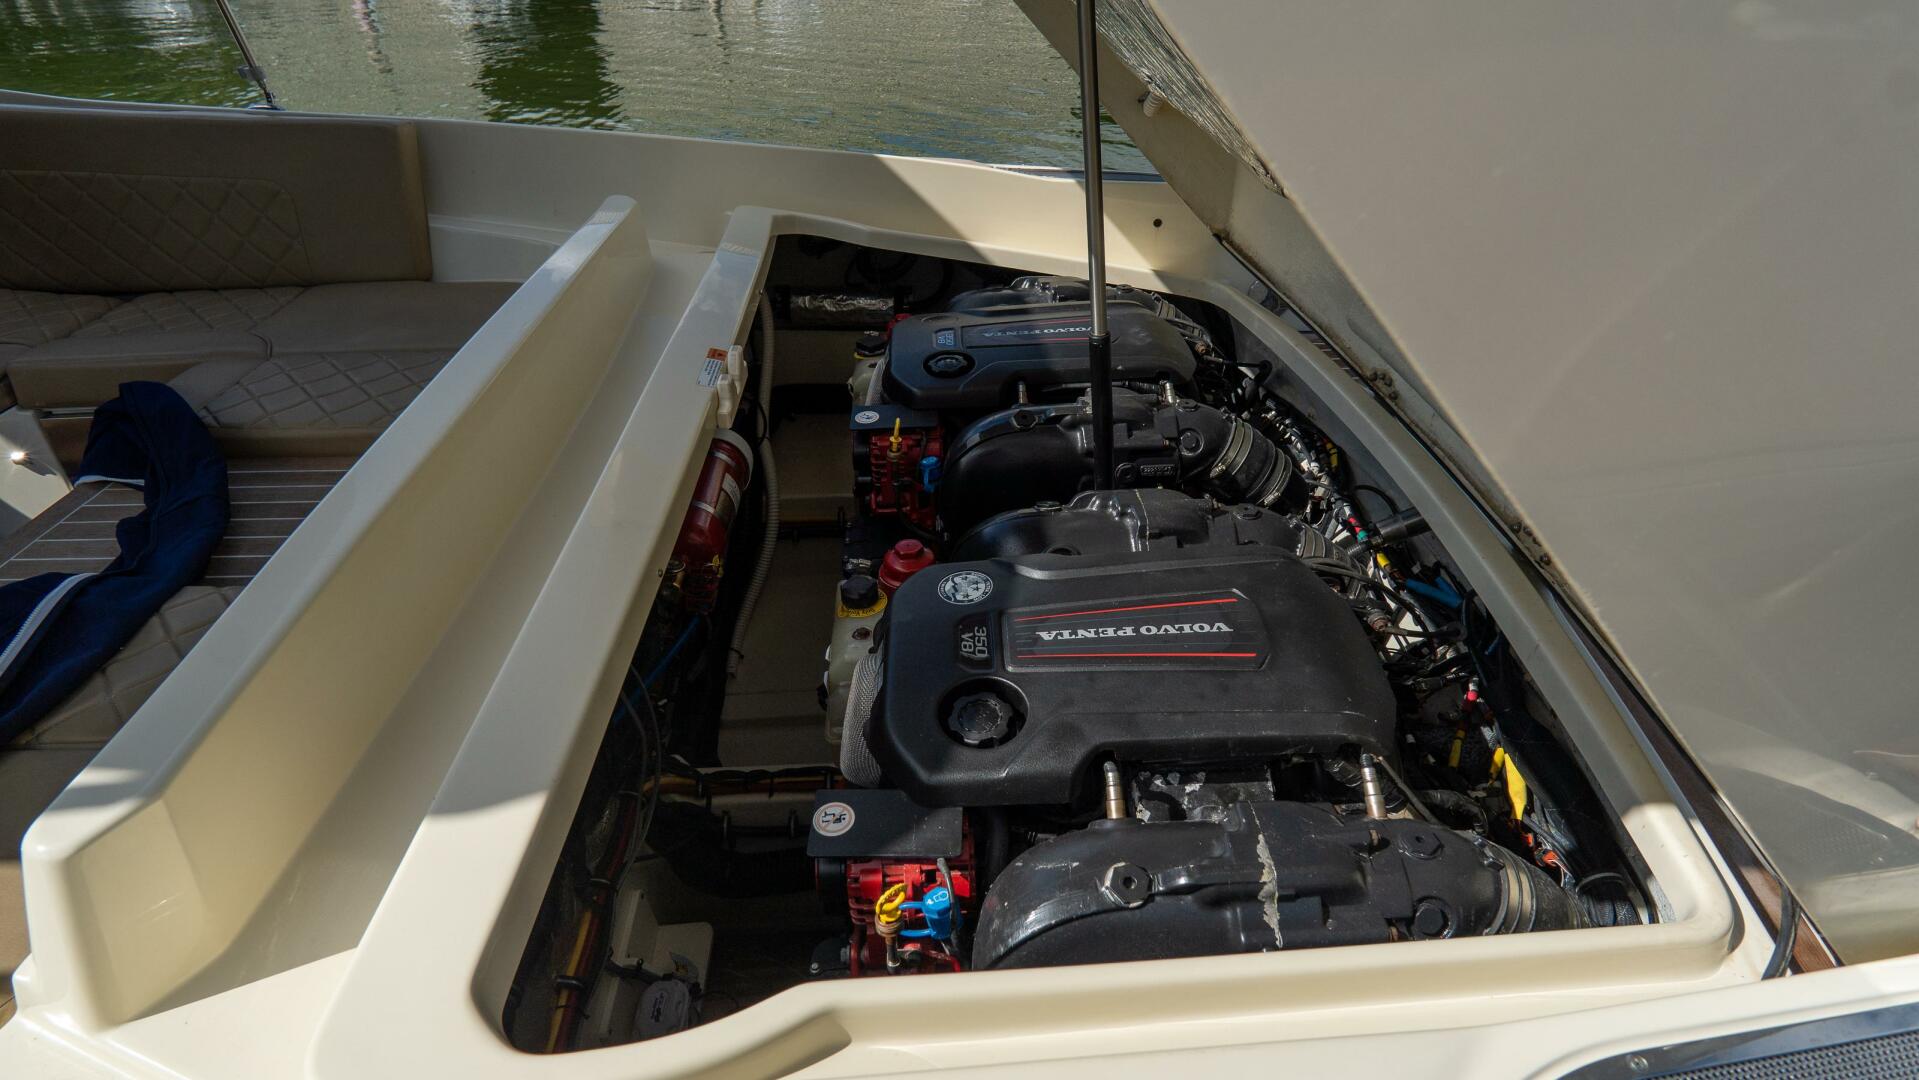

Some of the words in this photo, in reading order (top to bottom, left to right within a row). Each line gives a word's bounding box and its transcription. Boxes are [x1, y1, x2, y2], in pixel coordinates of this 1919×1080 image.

[937, 335, 946, 344] V8
[945, 331, 954, 346] 350
[982, 329, 1040, 338] PENTA
[1036, 626, 1136, 641] PENTA
[1139, 622, 1234, 635] VOLVO
[961, 632, 974, 652] V8
[974, 626, 988, 657] 350
